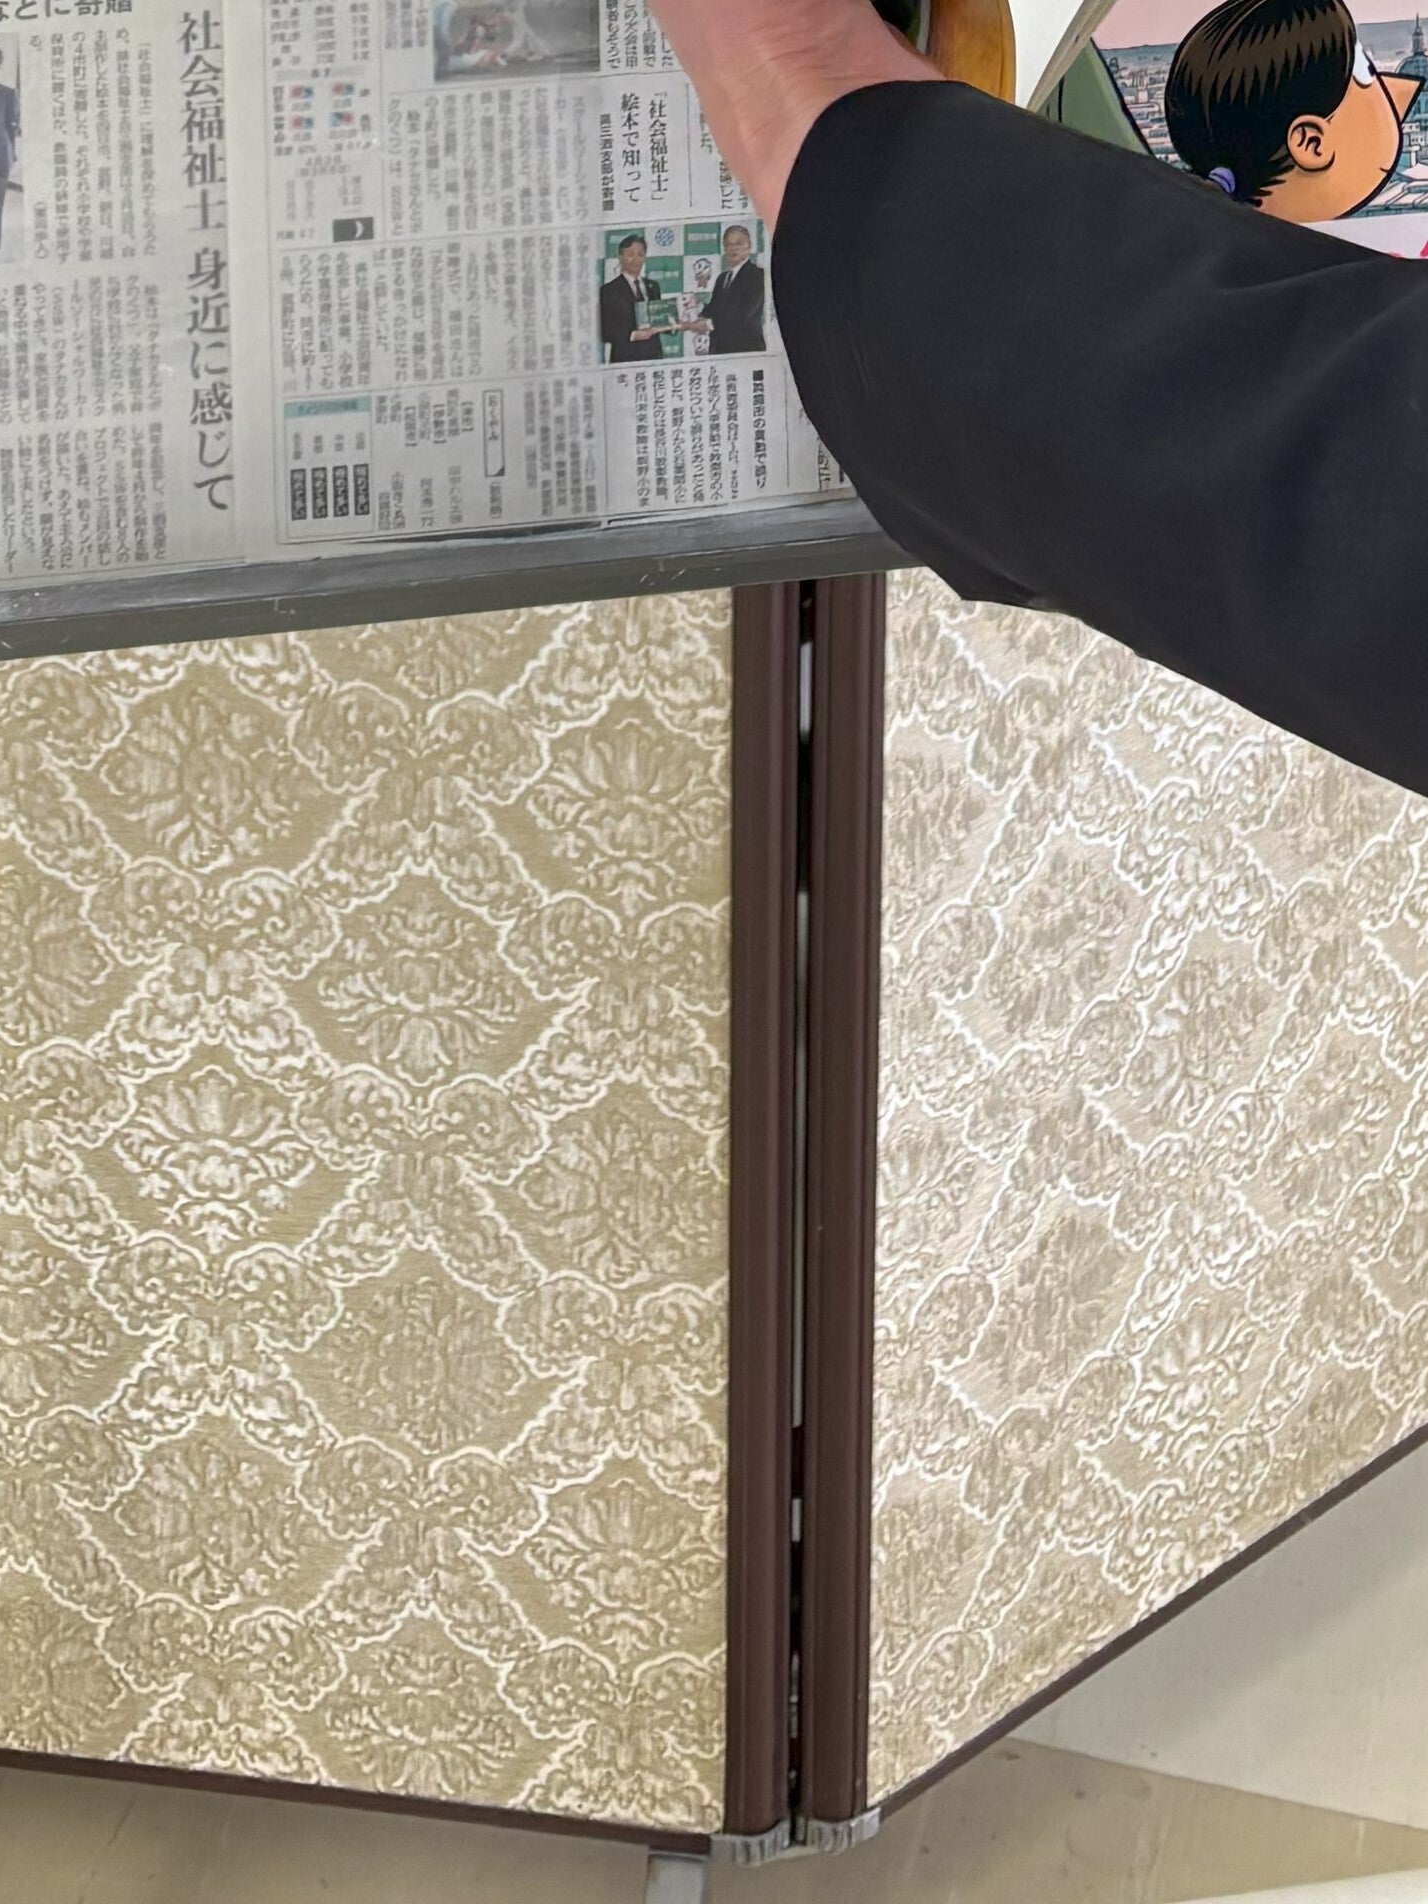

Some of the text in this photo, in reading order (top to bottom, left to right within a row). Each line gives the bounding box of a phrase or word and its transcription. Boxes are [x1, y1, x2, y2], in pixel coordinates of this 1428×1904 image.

[621, 92, 642, 204] 絵本で知って
[649, 91, 669, 202] 「社会福祉士」
[177, 9, 235, 512] 社会福祉士 身近に感じて
